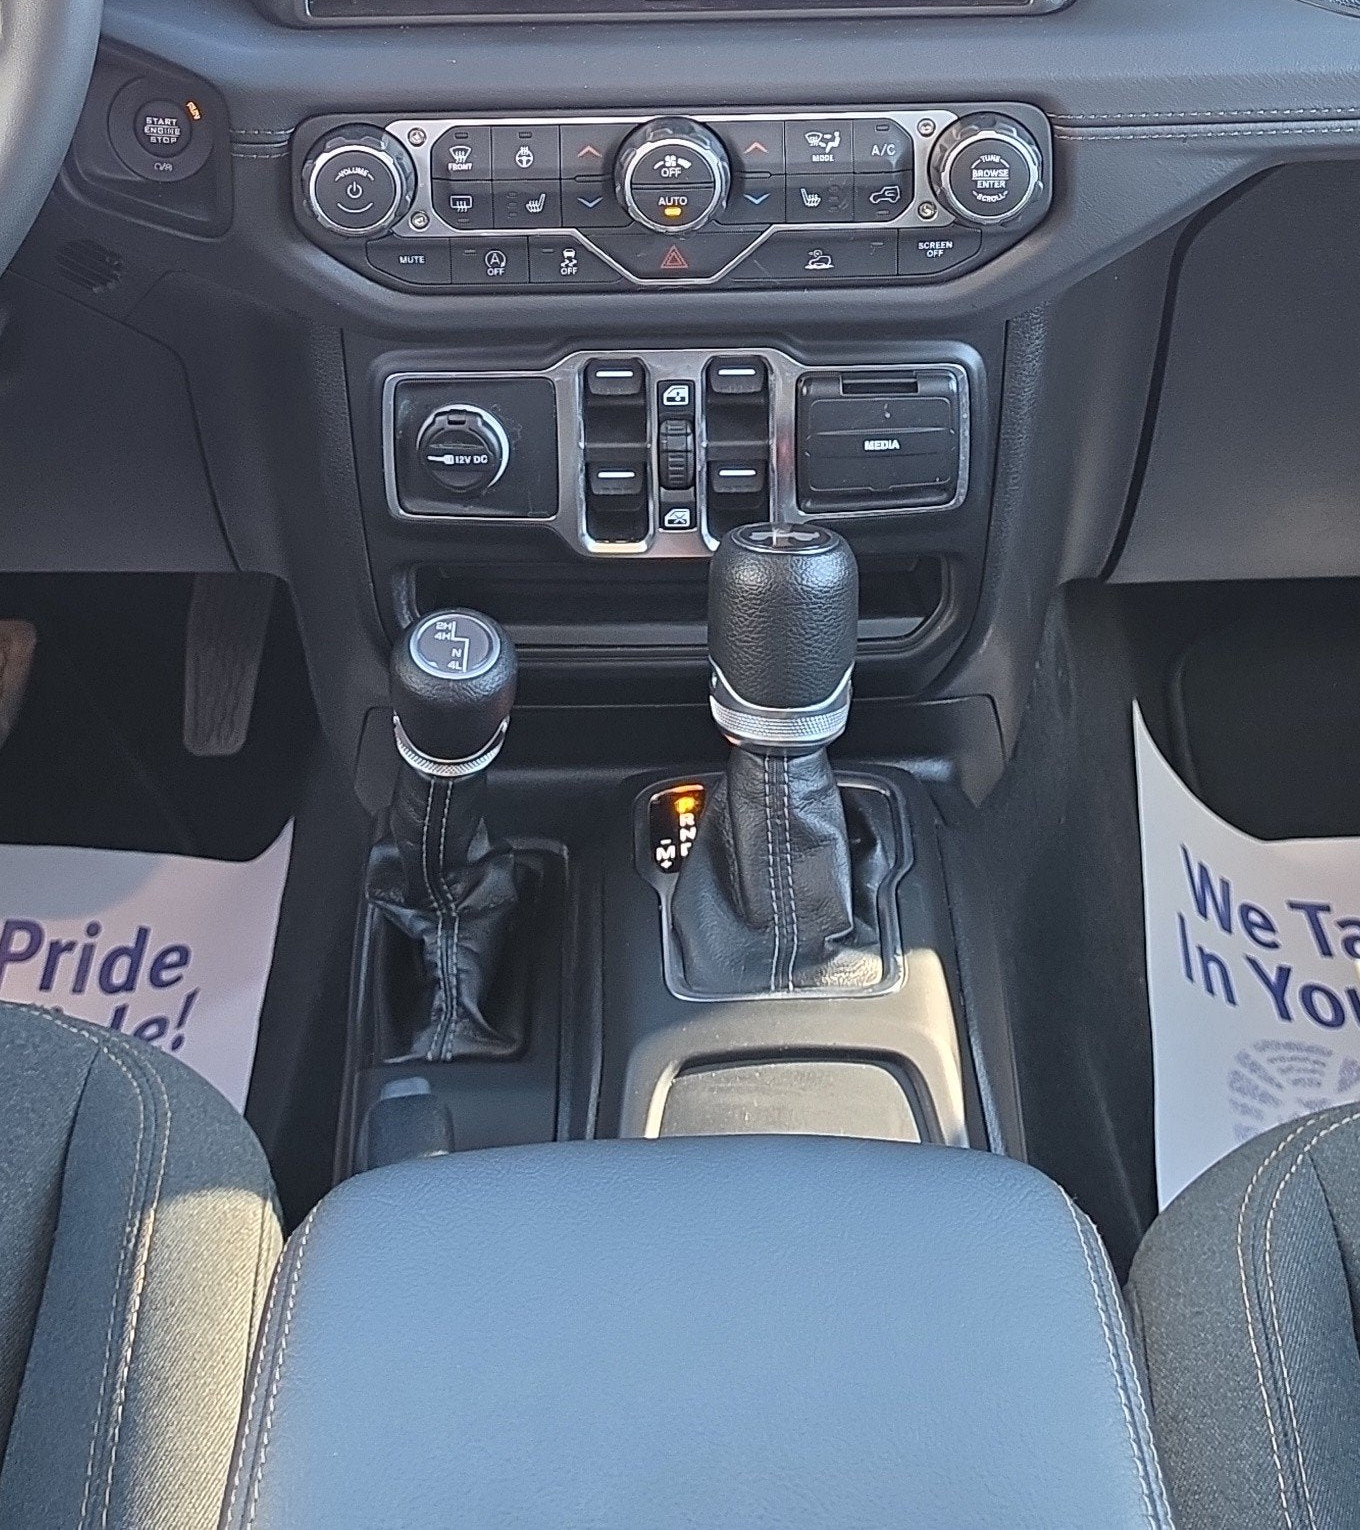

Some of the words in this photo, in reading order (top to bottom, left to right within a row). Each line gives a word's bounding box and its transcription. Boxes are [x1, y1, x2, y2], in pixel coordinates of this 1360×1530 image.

[146, 117, 178, 126] START
[144, 126, 181, 135] ENGINE
[150, 136, 177, 144] STOP
[871, 143, 896, 158] A/C
[812, 154, 834, 162] MODE
[980, 154, 1001, 164] TUNE
[448, 162, 473, 171] FRONT
[338, 167, 370, 178] VOLUME
[660, 167, 682, 178] OFF
[972, 169, 1009, 178] BROWSE
[976, 179, 1006, 189] ENTER
[657, 195, 688, 207] AUTO
[975, 191, 1005, 203] SCROLL
[918, 241, 953, 250] SCREEN
[926, 249, 944, 258] OFF
[399, 255, 426, 264] MUTE
[487, 268, 505, 276] OFF
[560, 266, 578, 275] OFF
[864, 438, 900, 452] MEDIA
[454, 454, 472, 464] 12V
[474, 454, 488, 464] DC
[436, 622, 452, 630] 2H
[434, 632, 451, 640] 4H
[451, 648, 462, 657] N
[447, 660, 462, 670] 4L
[679, 813, 695, 827] R
[680, 826, 697, 842] N
[656, 845, 676, 861] M
[1180, 844, 1280, 948] We
[1177, 912, 1238, 1008] In
